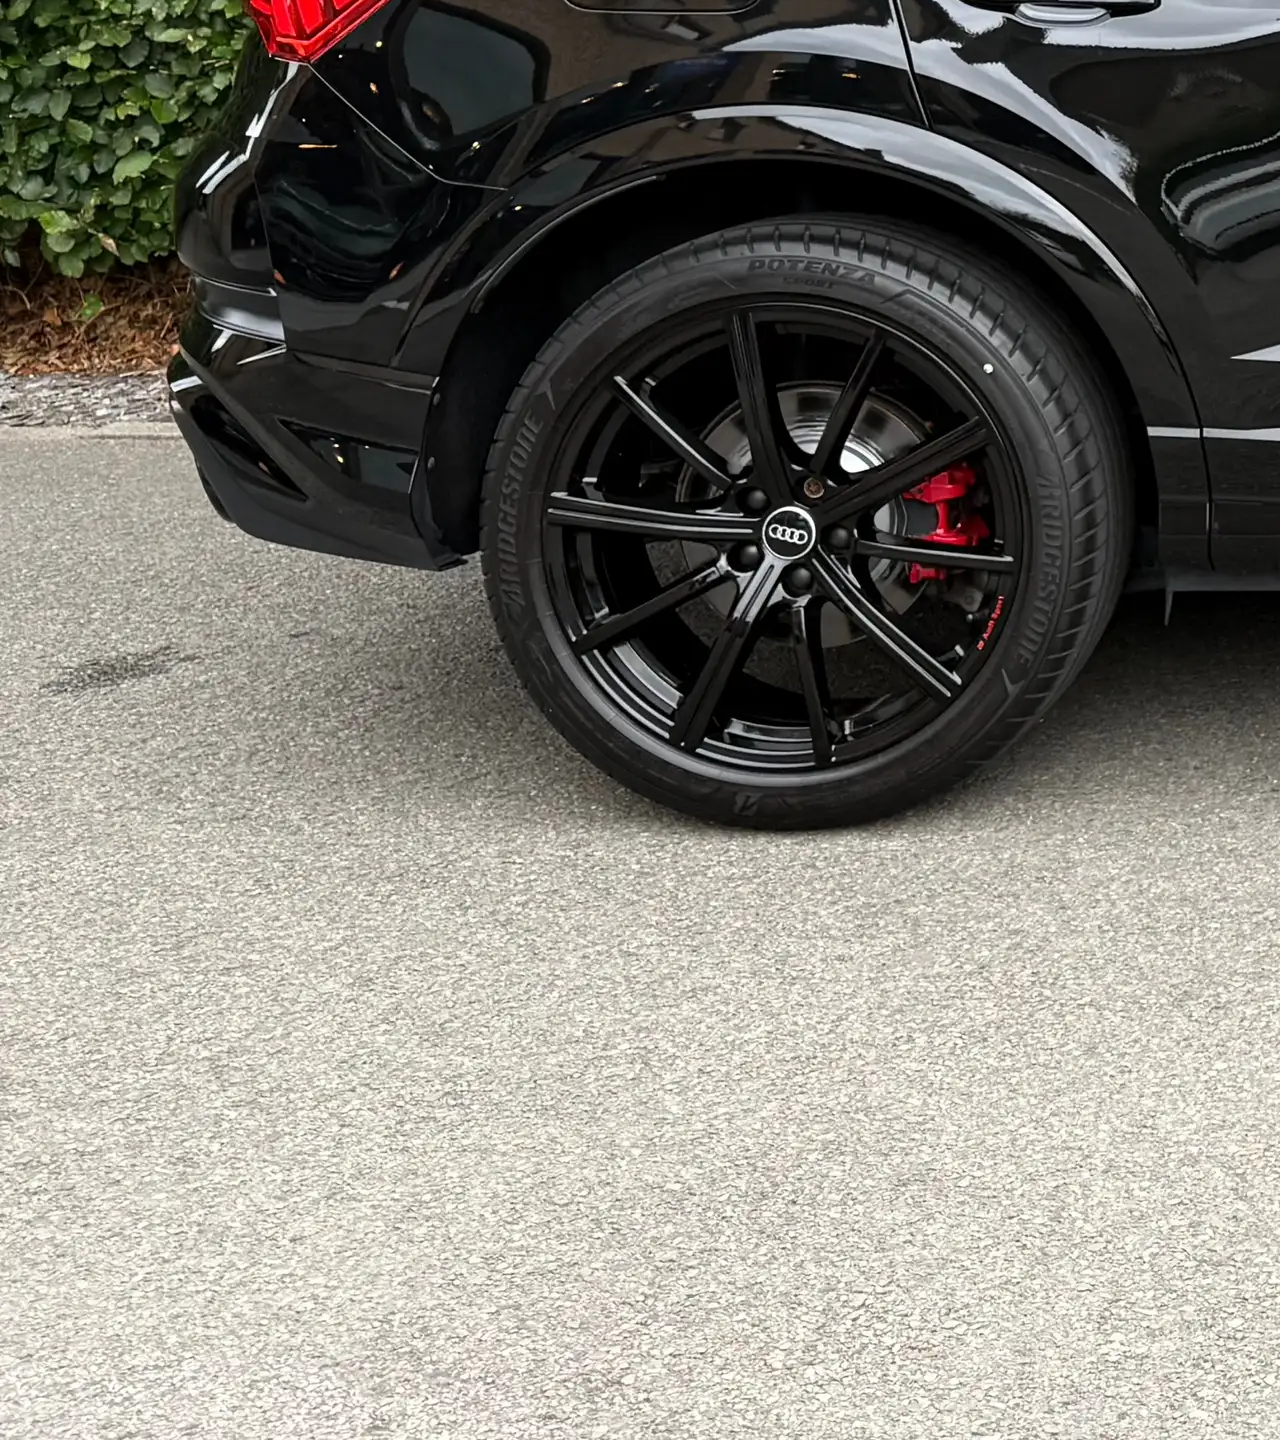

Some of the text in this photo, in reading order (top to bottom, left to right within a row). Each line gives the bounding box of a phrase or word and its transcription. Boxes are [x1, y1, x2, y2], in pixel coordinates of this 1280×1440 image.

[748, 259, 876, 288] POTENZA
[497, 409, 544, 607] BRIDGESTONE
[1014, 472, 1063, 667] BRIDGESTONE
